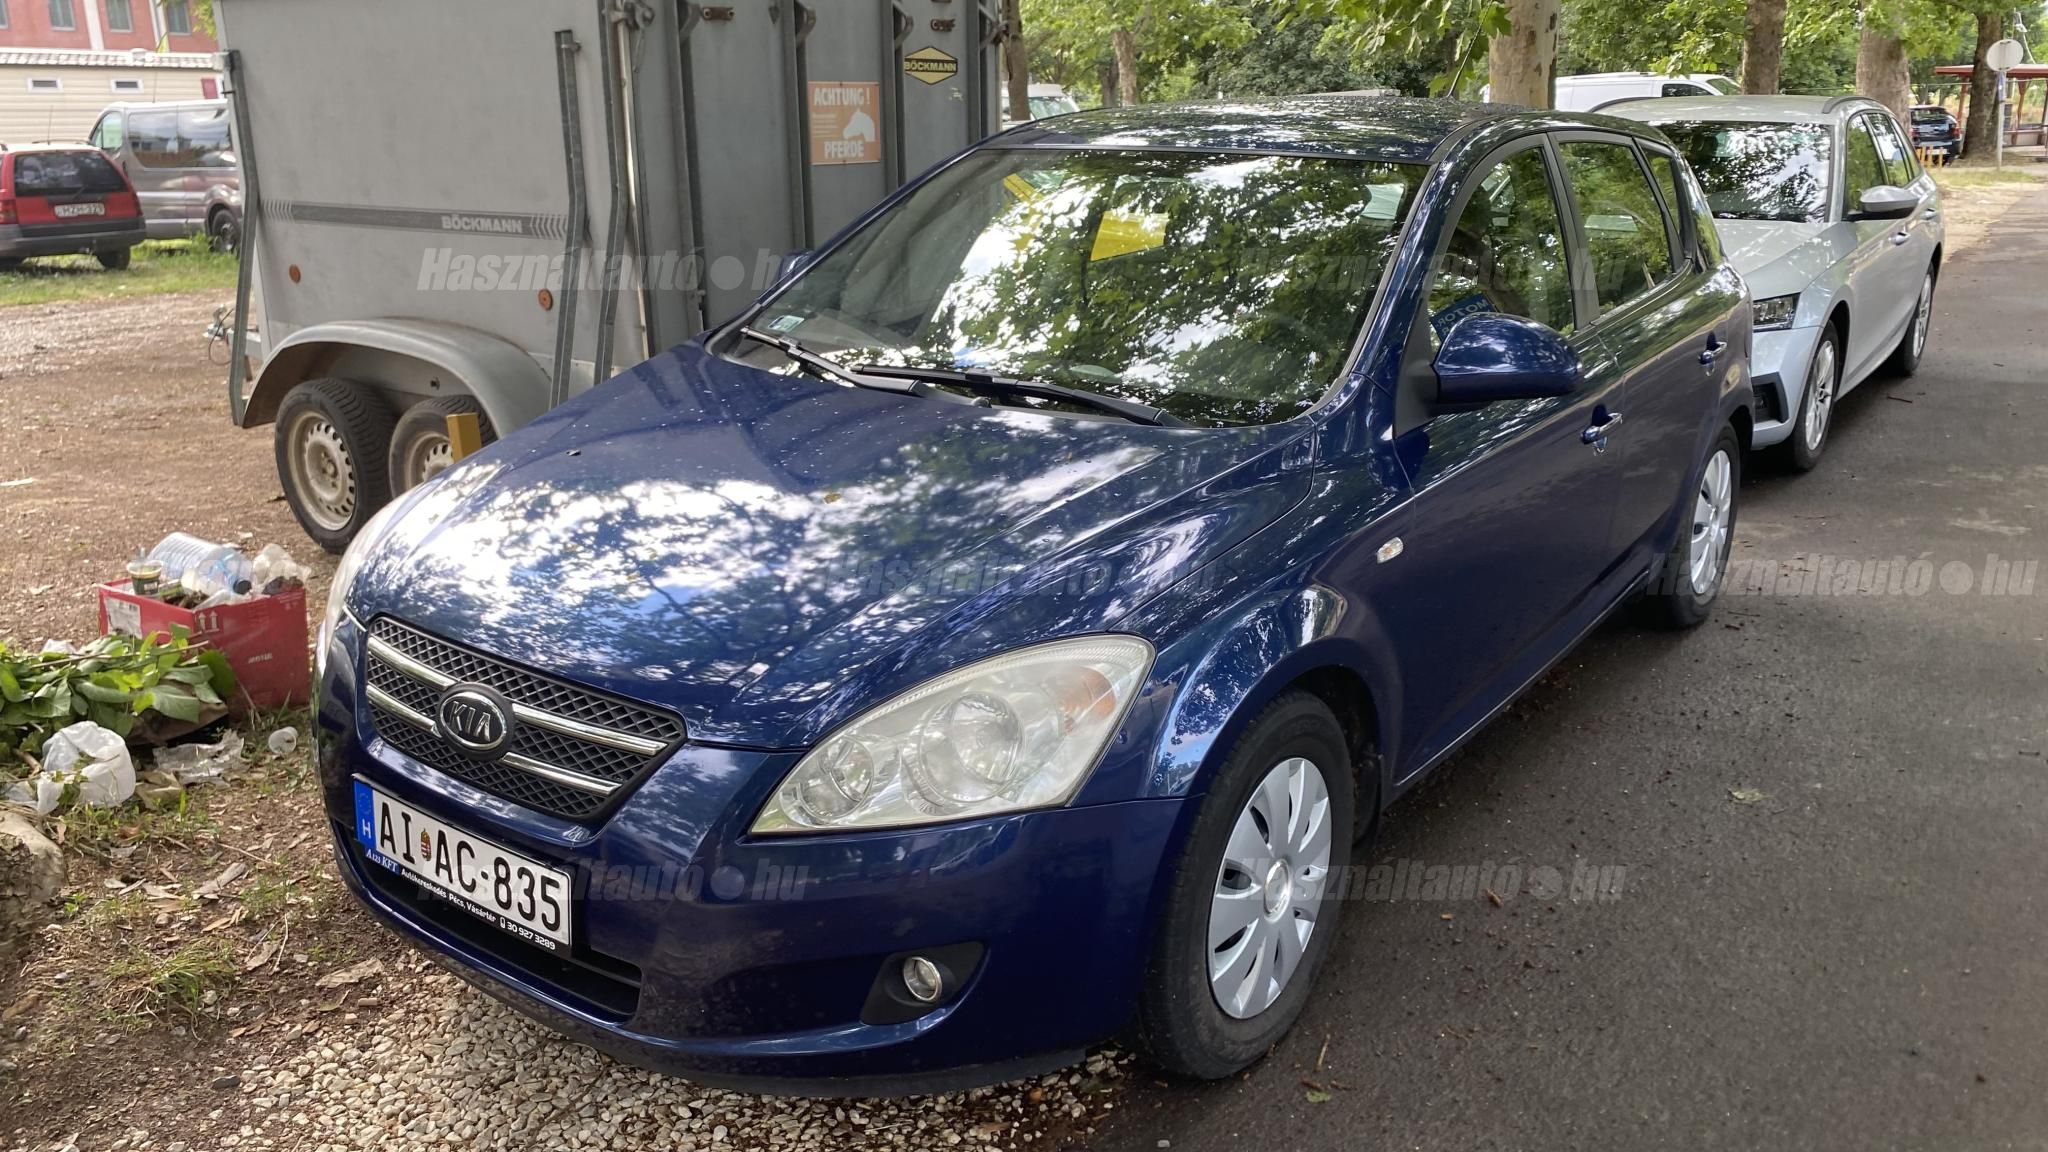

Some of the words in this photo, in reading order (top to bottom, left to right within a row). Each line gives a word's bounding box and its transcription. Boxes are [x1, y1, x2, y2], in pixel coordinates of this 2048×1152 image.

[904, 60, 957, 73] BÖCKMANN
[814, 87, 864, 106] ACHTUNG
[824, 141, 865, 159] PFERDE
[441, 214, 523, 233] BÖCKMANN
[449, 700, 491, 742] KIA
[362, 818, 372, 839] H
[380, 801, 416, 864] AI
[382, 855, 399, 872] KFT
[449, 893, 466, 909] Pécs,
[507, 921, 518, 933] 30
[518, 927, 534, 940] 927
[534, 934, 556, 950] 3289
